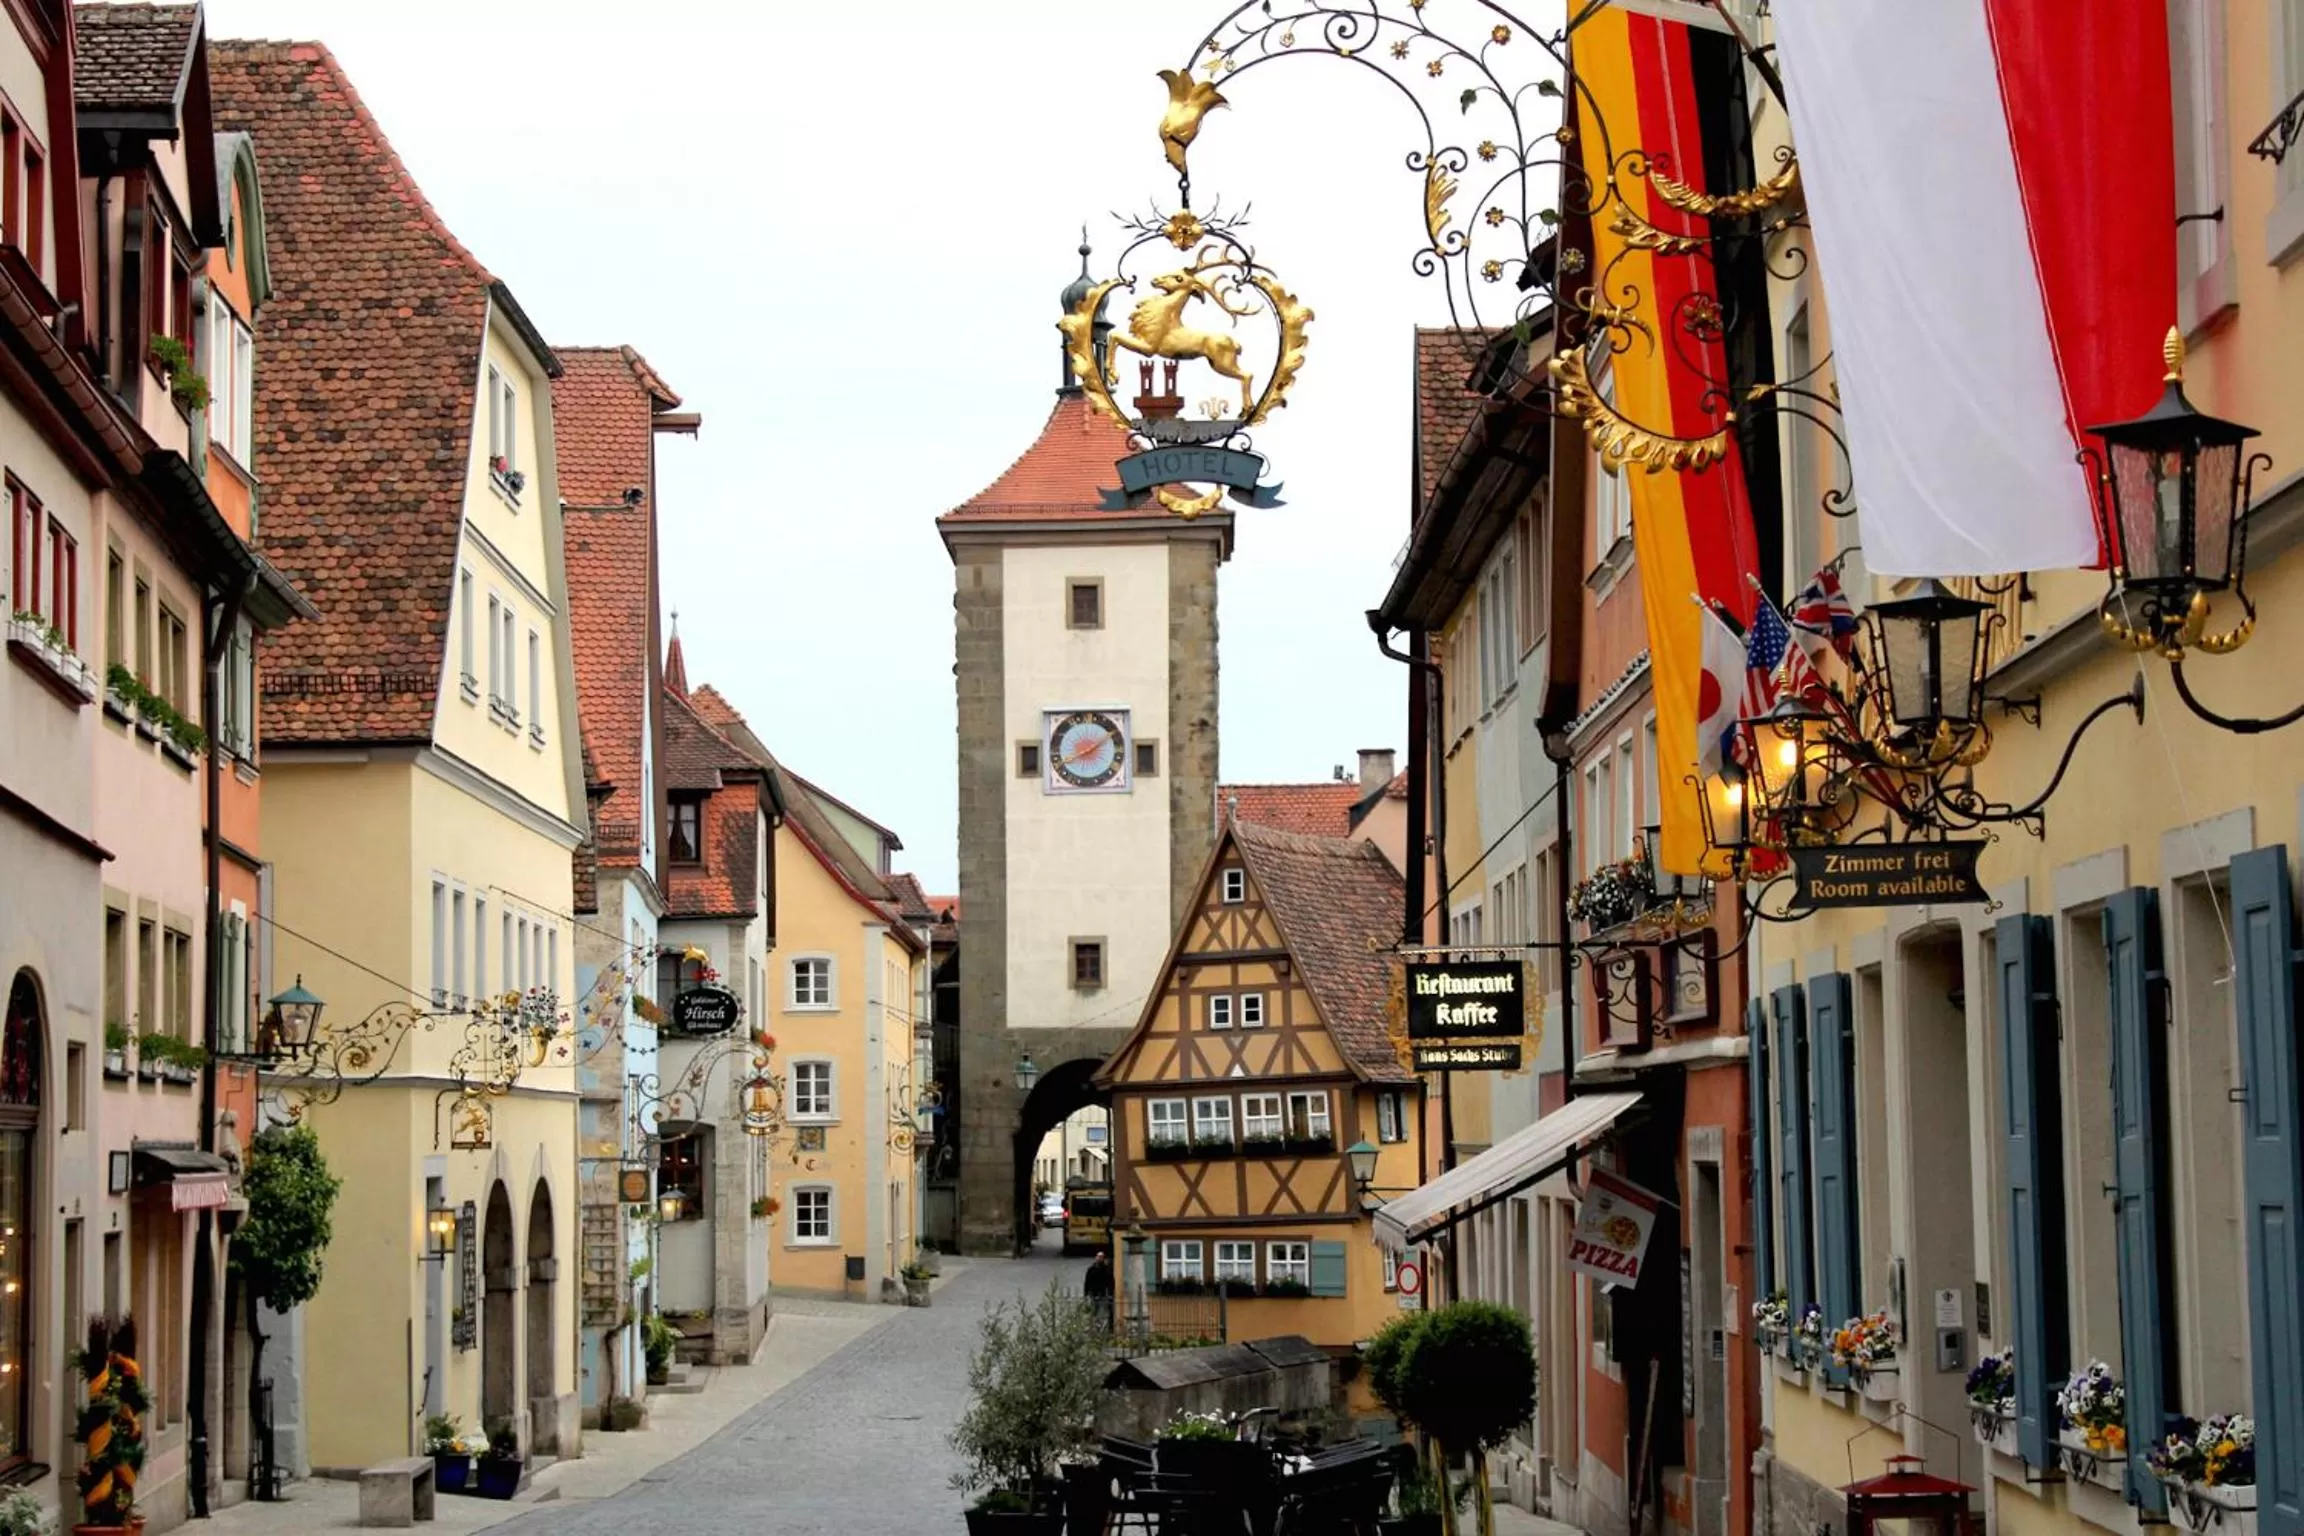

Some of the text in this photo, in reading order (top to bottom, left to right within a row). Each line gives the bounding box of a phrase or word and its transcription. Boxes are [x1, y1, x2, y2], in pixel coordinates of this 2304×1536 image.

[1141, 451, 1235, 478] HOTEL
[1825, 851, 1950, 873] Zimmer frei
[1811, 876, 1966, 898] Room available
[1416, 973, 1514, 997] Restaurant
[683, 1005, 725, 1019] Hirsch
[1436, 1002, 1498, 1026] Kaffee
[1450, 1048, 1480, 1062] Sachs
[1481, 1048, 1513, 1062] Stub
[1569, 1240, 1638, 1278] PIZZA
